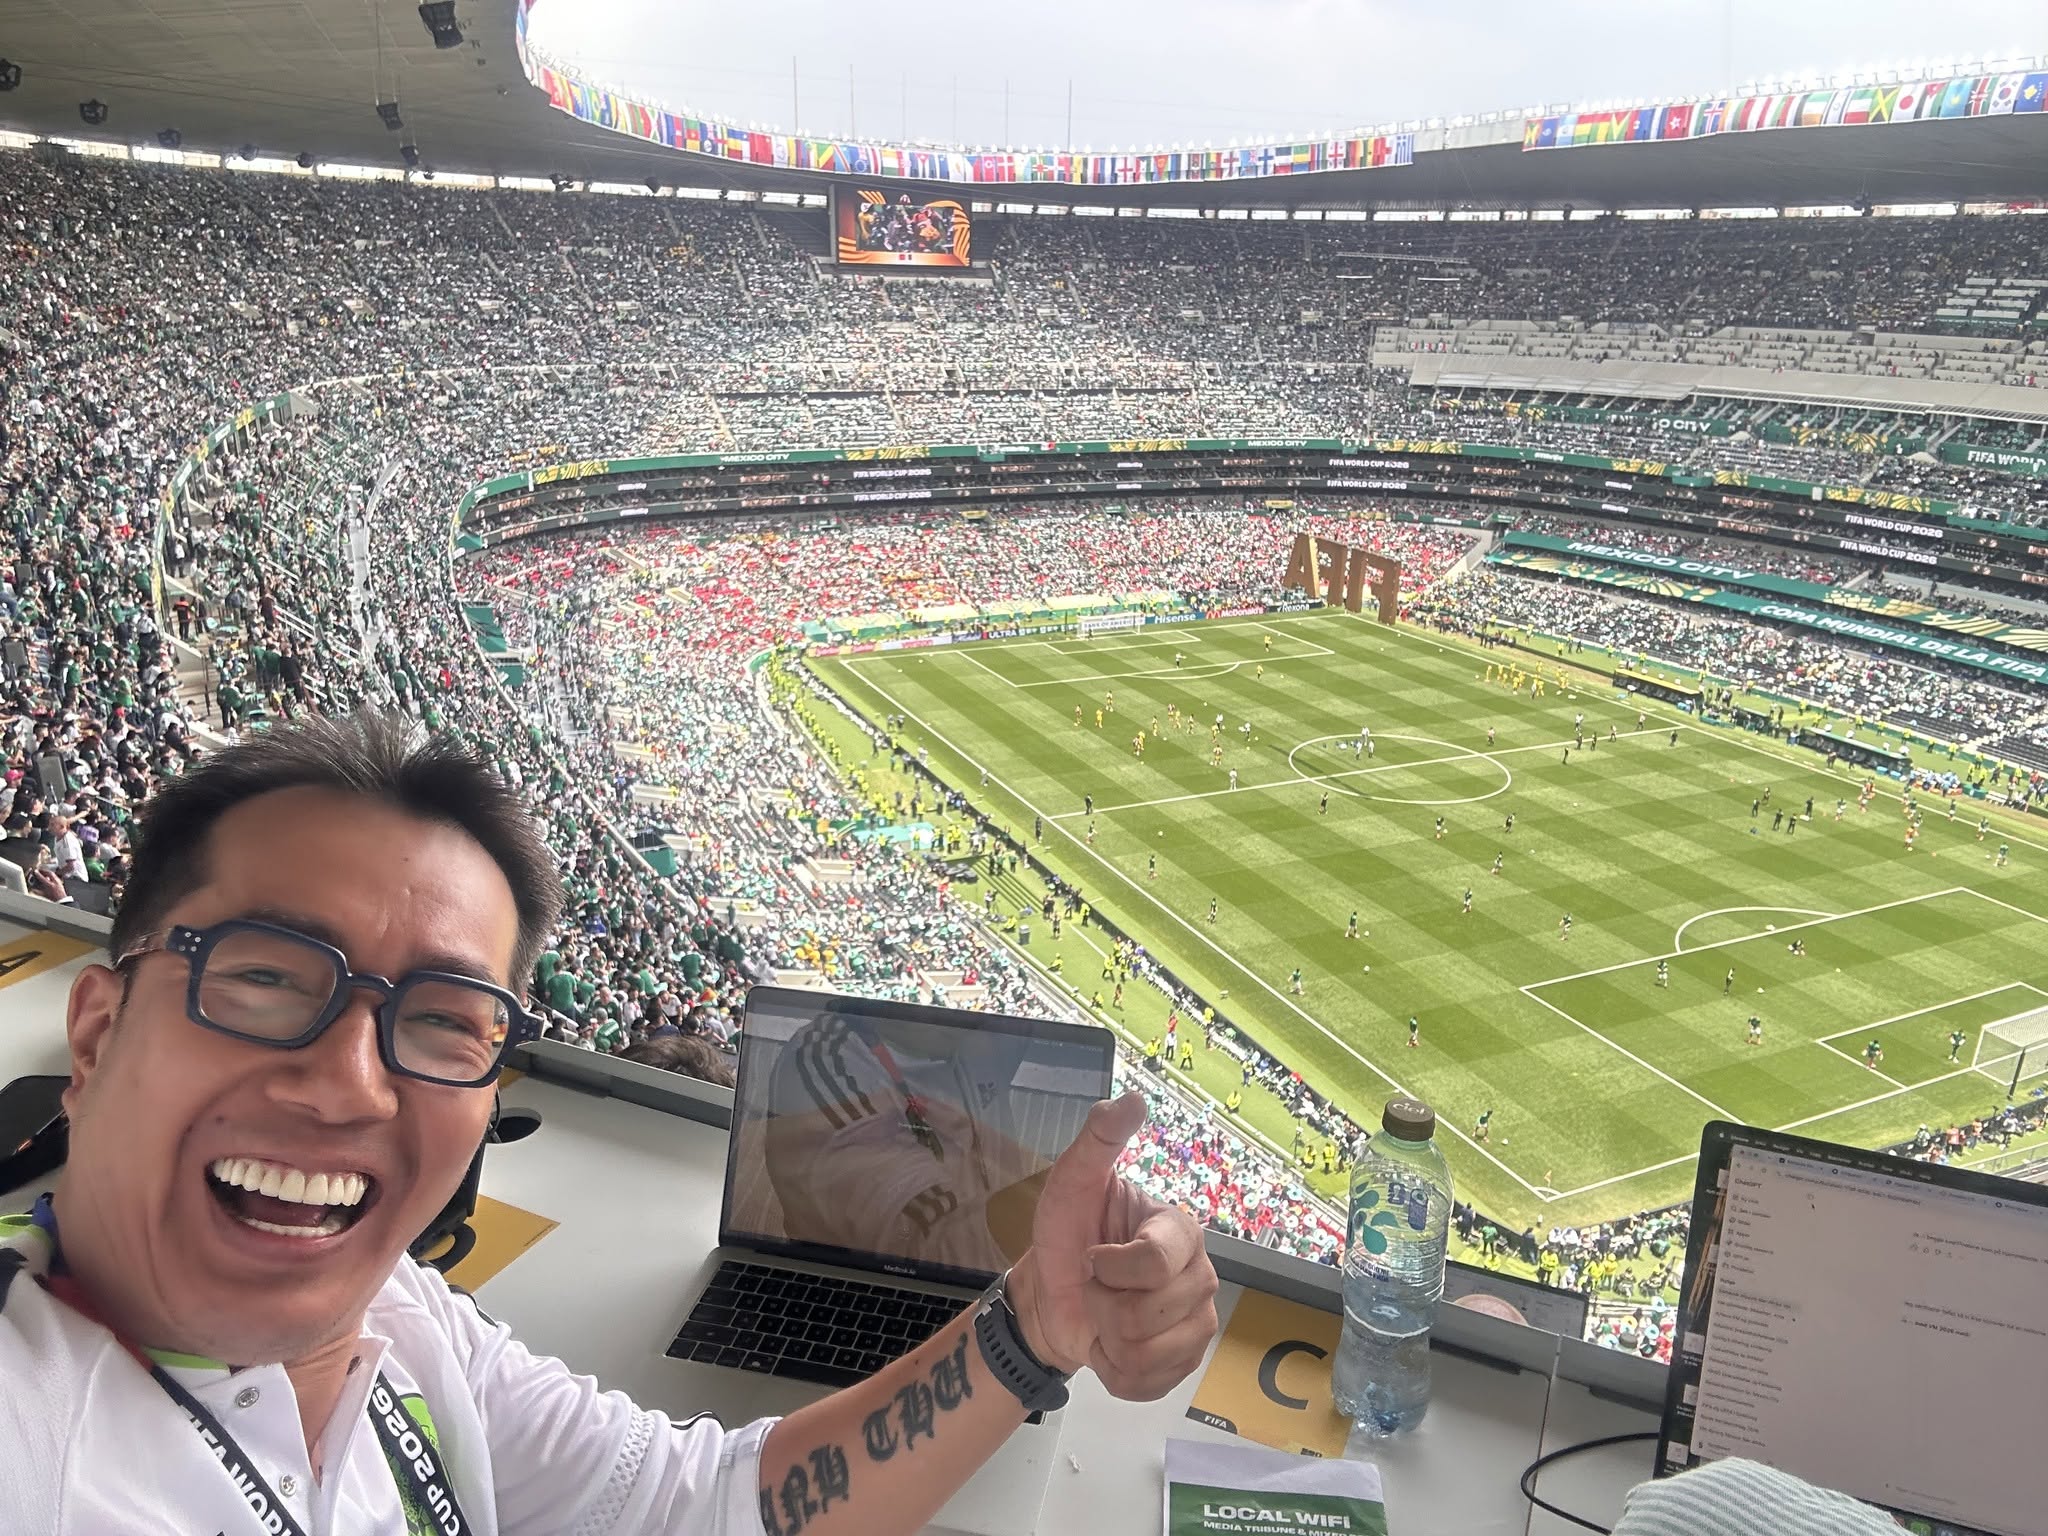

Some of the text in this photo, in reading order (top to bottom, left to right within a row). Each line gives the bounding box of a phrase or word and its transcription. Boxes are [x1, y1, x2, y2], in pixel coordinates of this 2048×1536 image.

[724, 453, 789, 462] MEXICO CITY
[1968, 450, 1995, 464] FIFA
[854, 470, 869, 478] FIFA
[870, 470, 892, 478] WORLD
[894, 469, 907, 477] CUP
[1382, 482, 1407, 490] 2026
[854, 493, 869, 501] FIFA
[894, 492, 907, 500] CUP
[1845, 515, 1943, 538] FIFA WORLD CUP 2026
[1840, 540, 1937, 565] FIFA WORLD CUP 2026
[1567, 542, 1755, 580] MEXICO CITY
[1154, 613, 1196, 624] Hisense
[1221, 606, 1264, 617] McDonald's
[989, 630, 1017, 639] ULTRA
[1760, 605, 2048, 678] COPA MUNDIAL DE LA FIFA
[884, 1264, 908, 1274] MacBook
[1258, 1340, 1328, 1410] C
[1204, 1415, 1227, 1429] FIFA
[371, 1386, 460, 1536] CUP 2026
[1204, 1504, 1350, 1529] LOCAL WIFI
[1204, 1520, 1242, 1531] MEDIA
[1244, 1525, 1296, 1535] TRIBUNE
